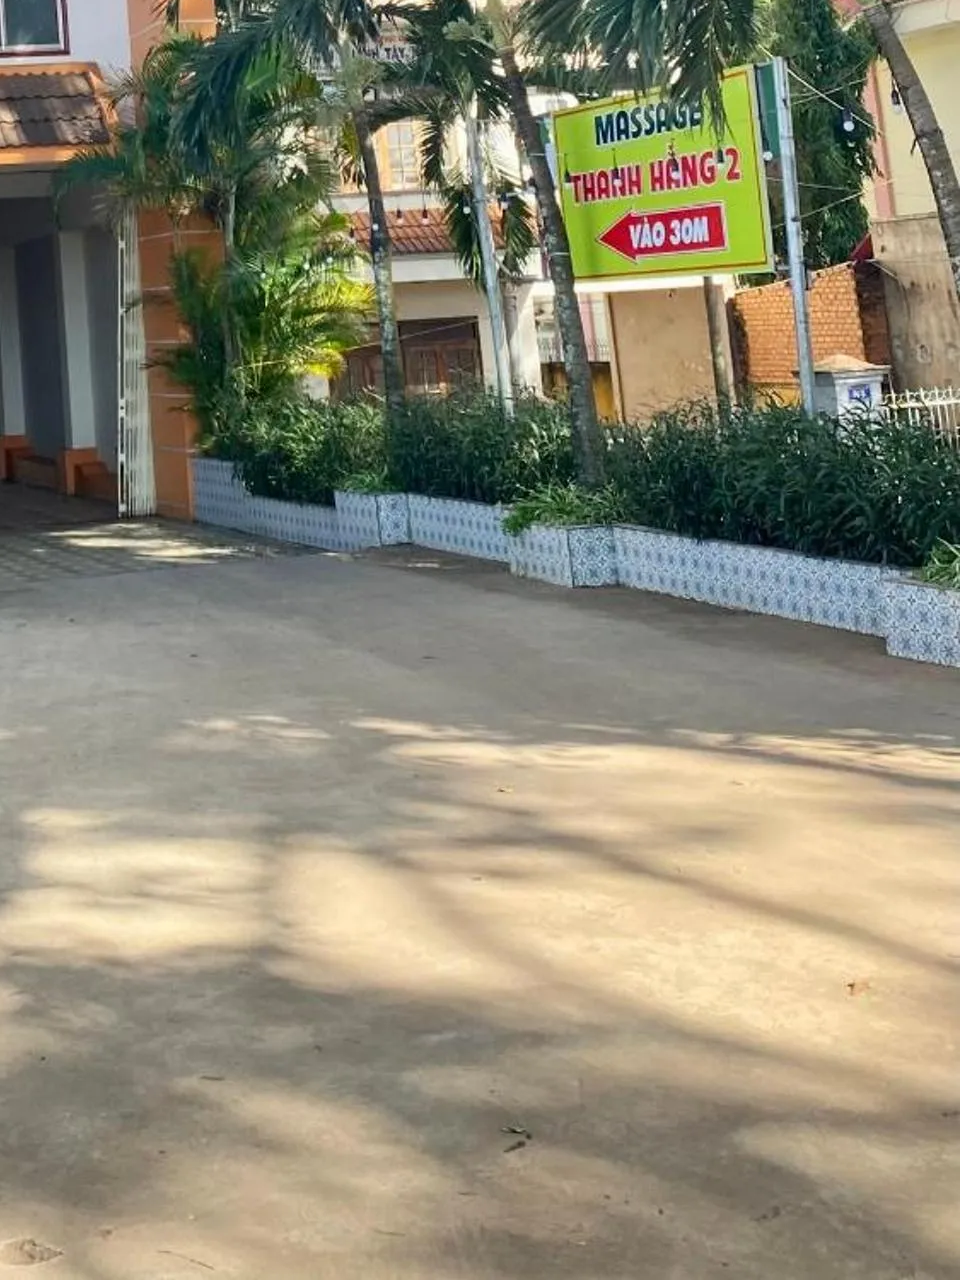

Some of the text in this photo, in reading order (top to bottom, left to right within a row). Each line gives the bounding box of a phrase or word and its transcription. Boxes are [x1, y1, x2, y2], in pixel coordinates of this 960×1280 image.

[594, 102, 703, 146] MASSAGE
[571, 164, 643, 204] THANH
[725, 147, 742, 182] 2
[629, 216, 709, 248] VÀO 30M
